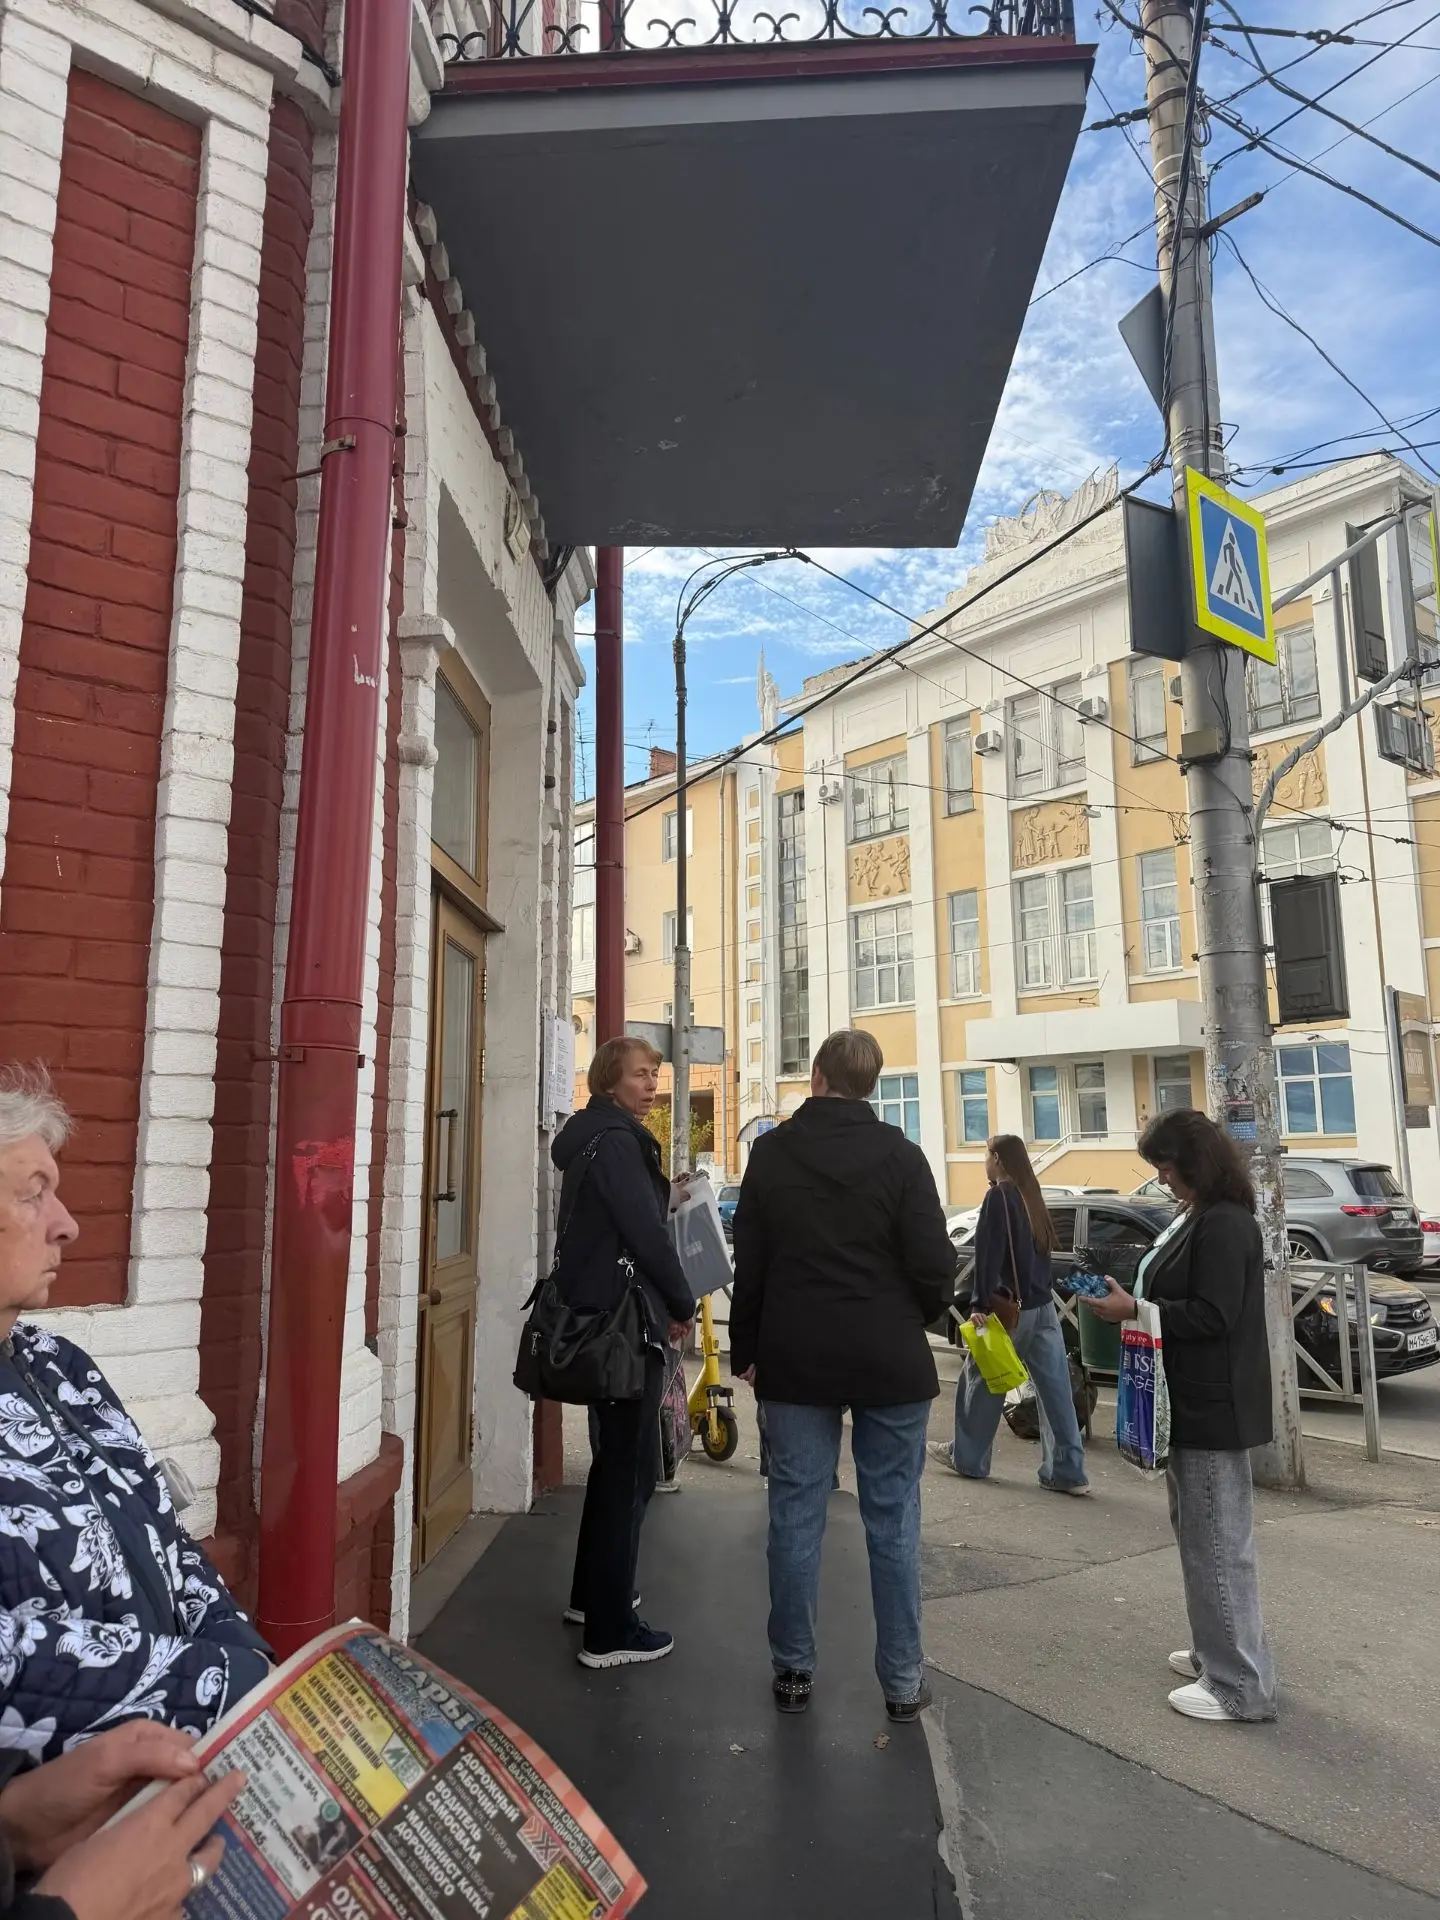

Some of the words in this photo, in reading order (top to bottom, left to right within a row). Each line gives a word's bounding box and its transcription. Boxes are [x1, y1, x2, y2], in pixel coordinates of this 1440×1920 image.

[250, 1727, 276, 1759] КАМАЗ
[484, 1719, 523, 1763] ВАКАНСИИ
[519, 1760, 564, 1815] САМАРСКОЙ
[431, 1778, 486, 1843] ВОДИТЕЛЬ
[451, 1760, 501, 1819] РАБОЧИЙ
[460, 1749, 522, 1823] ДОРОЖНЫЙ
[392, 1819, 457, 1898] ДОРОЖНОГО
[404, 1808, 462, 1880] МАШИНИСТ
[456, 1876, 491, 1919] КАТКА
[422, 1790, 484, 1865] САМОСВАЛА
[531, 1792, 591, 1866] КОМАНДИРОВКИ
